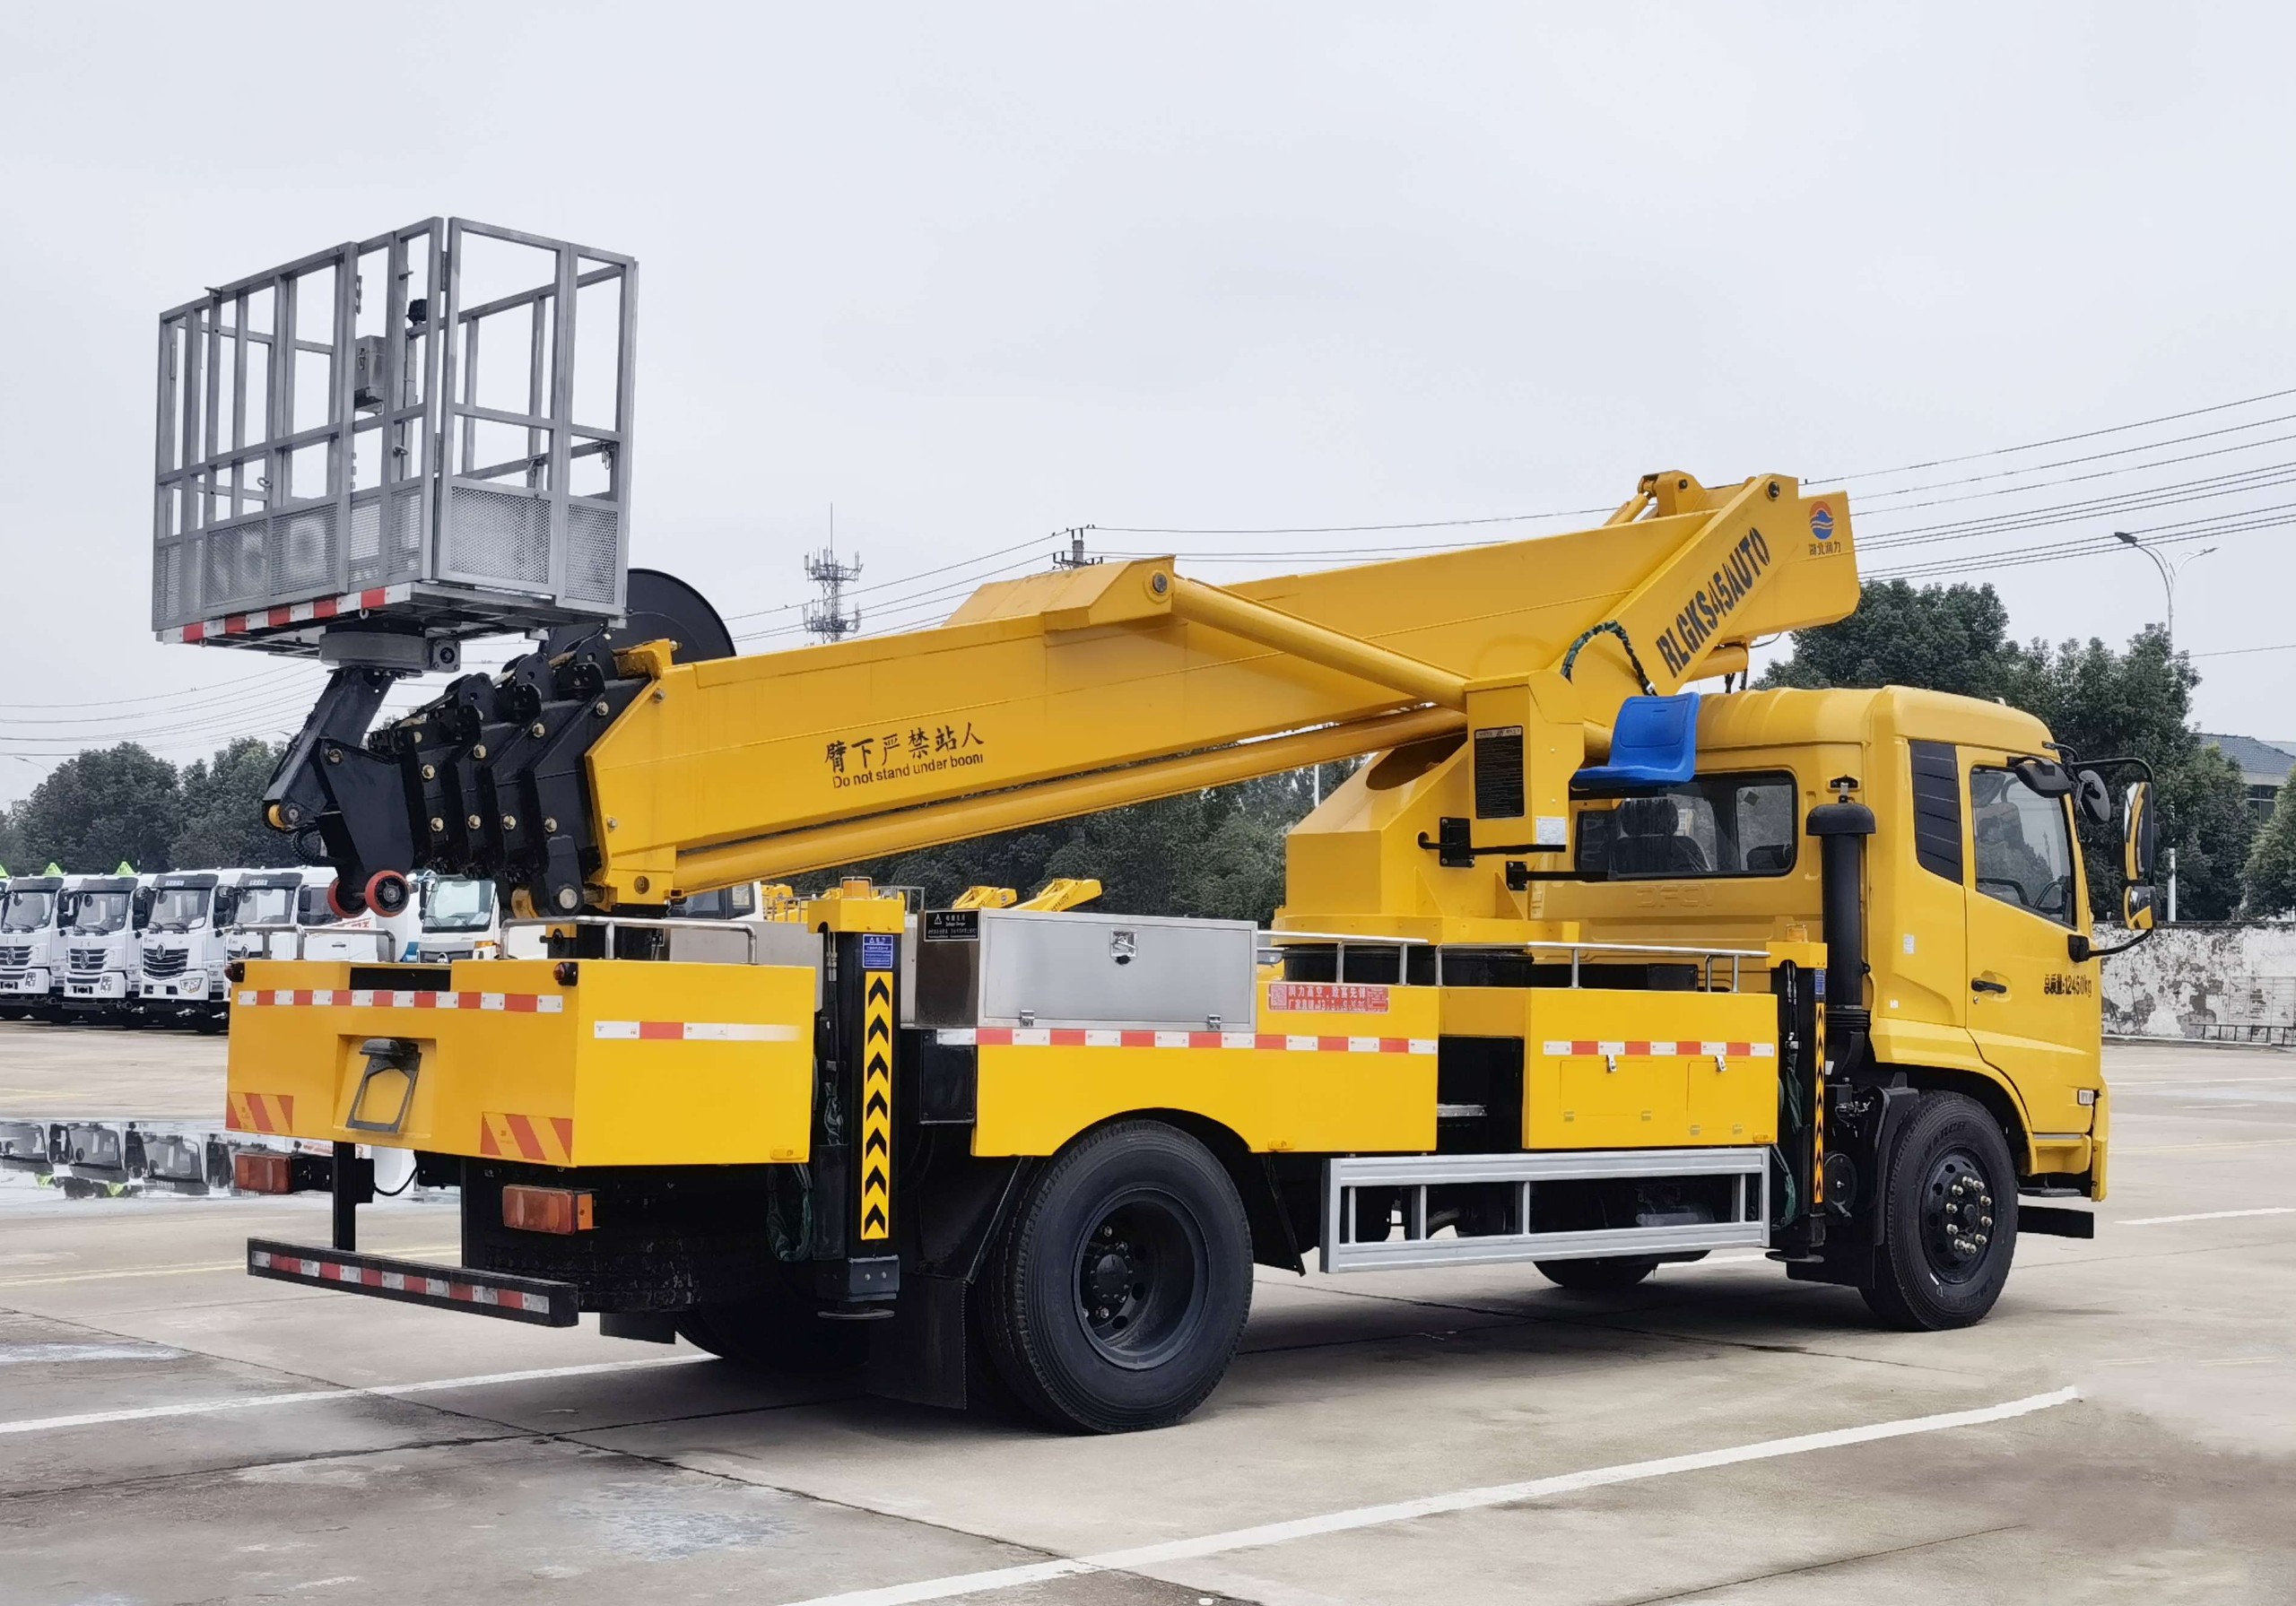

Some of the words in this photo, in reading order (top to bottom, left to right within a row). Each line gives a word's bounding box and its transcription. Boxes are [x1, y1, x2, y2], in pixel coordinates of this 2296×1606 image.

[1655, 526, 1770, 679] RLGKS45AUTO
[824, 721, 985, 774] 臂下严禁站人
[832, 776, 851, 789] Do
[853, 770, 874, 786] not
[876, 763, 910, 782] stand
[913, 759, 948, 775] under
[950, 753, 984, 768] boom
